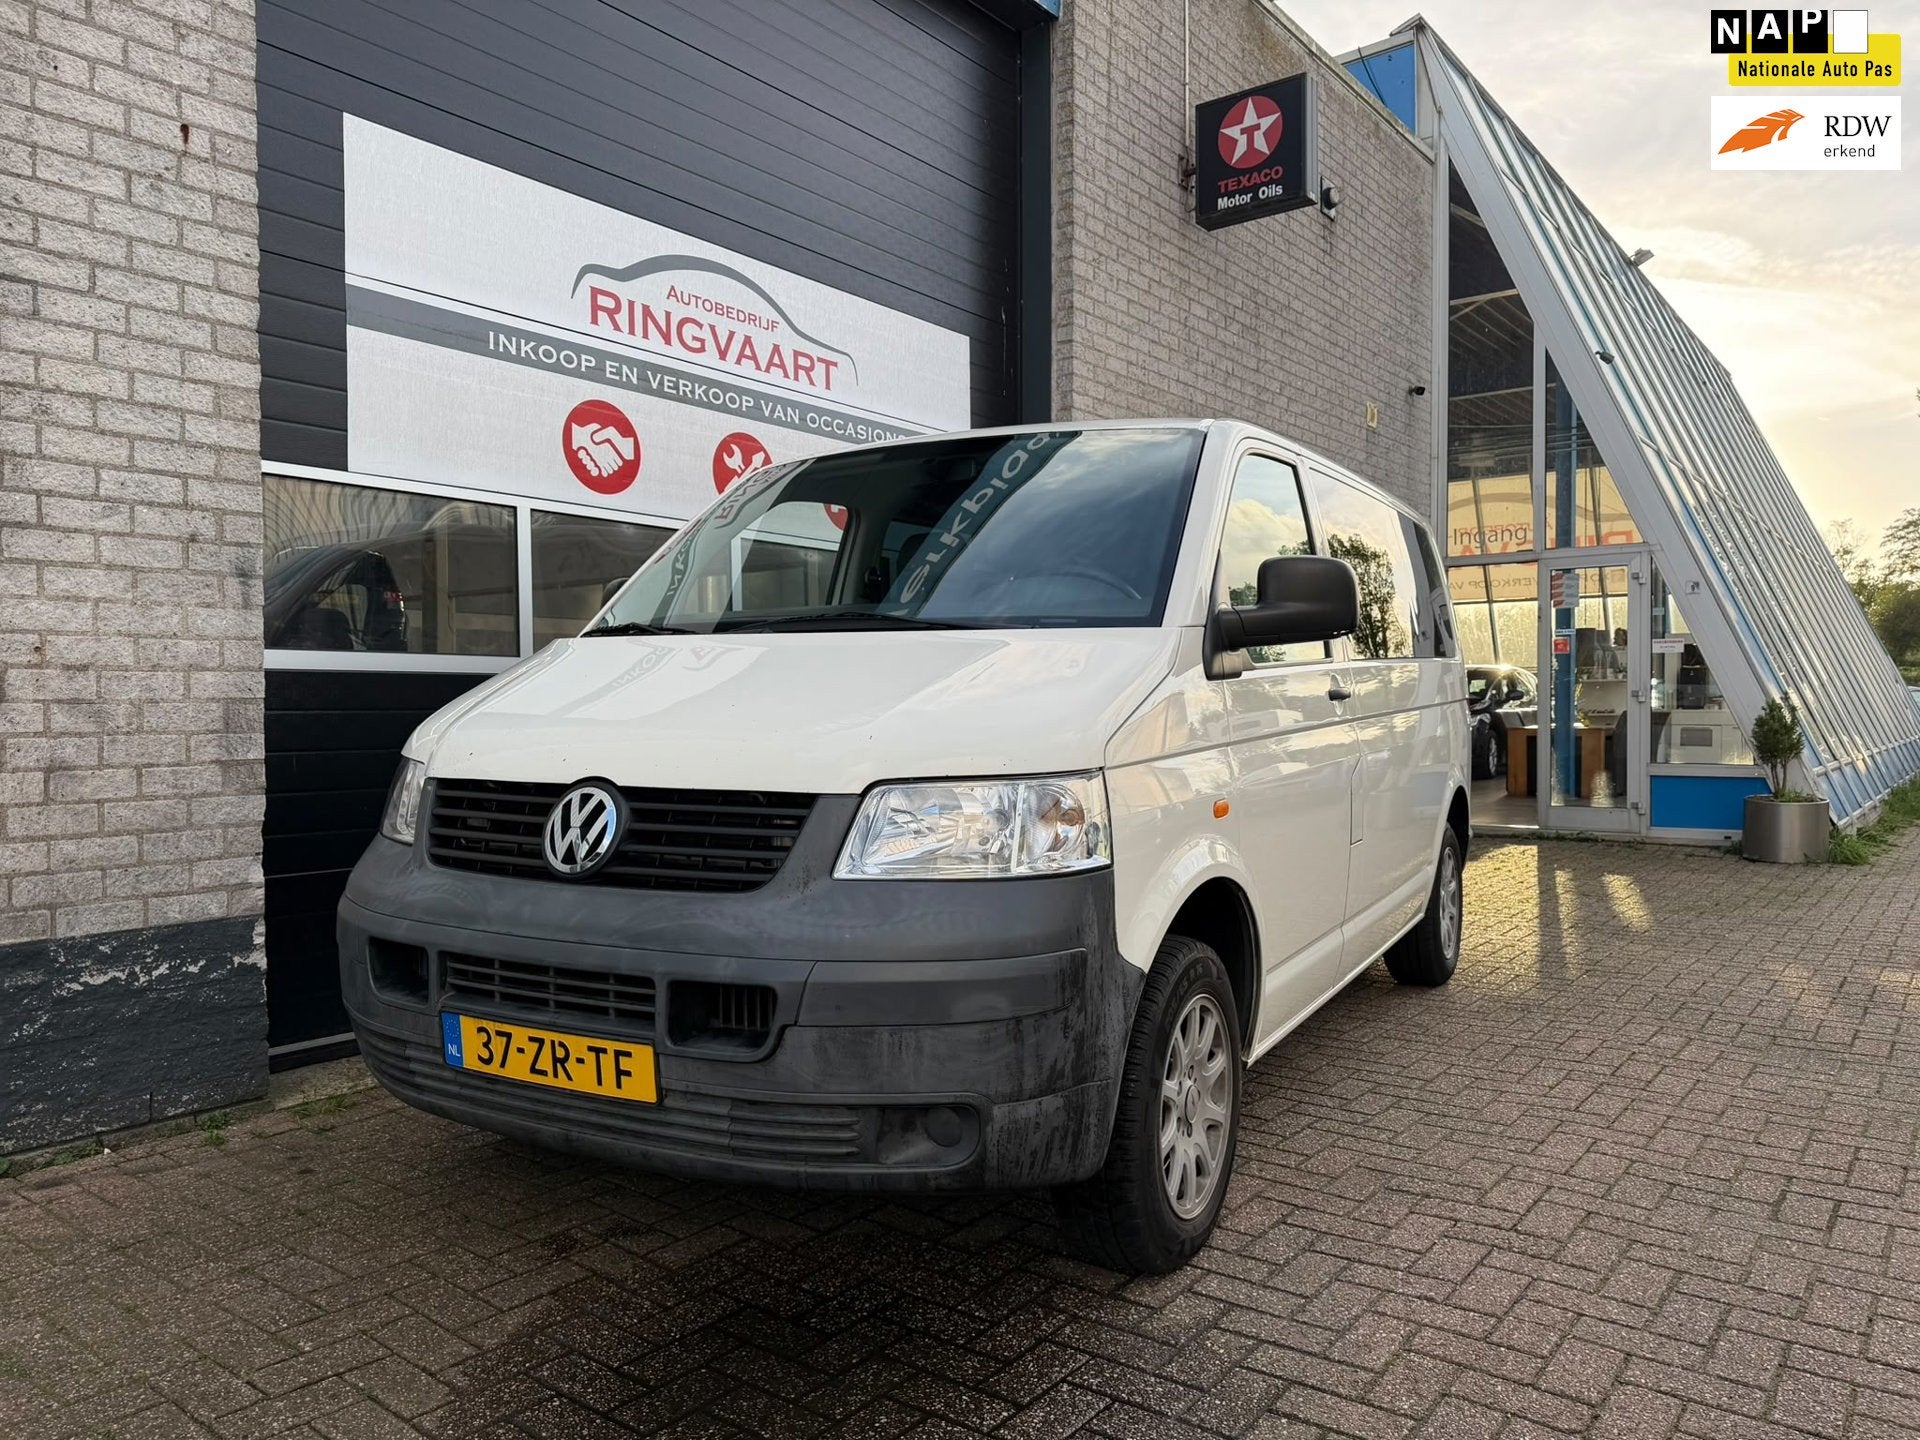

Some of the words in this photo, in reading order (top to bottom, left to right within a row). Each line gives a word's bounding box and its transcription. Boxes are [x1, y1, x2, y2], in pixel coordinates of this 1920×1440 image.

[1217, 165, 1284, 194] TEXACO
[1217, 192, 1253, 211] Motor
[1258, 184, 1284, 200] Oils
[666, 285, 780, 332] AUTOBEDRIJF
[589, 285, 839, 391] RINGVAART
[487, 331, 597, 373] INKOOP
[605, 361, 639, 385] EN
[646, 370, 755, 412] VERKOOP
[760, 399, 802, 426] VAN
[1454, 527, 1528, 549] Ingang
[448, 1042, 462, 1058] NL
[475, 1026, 633, 1090] 37-ZR-TF
